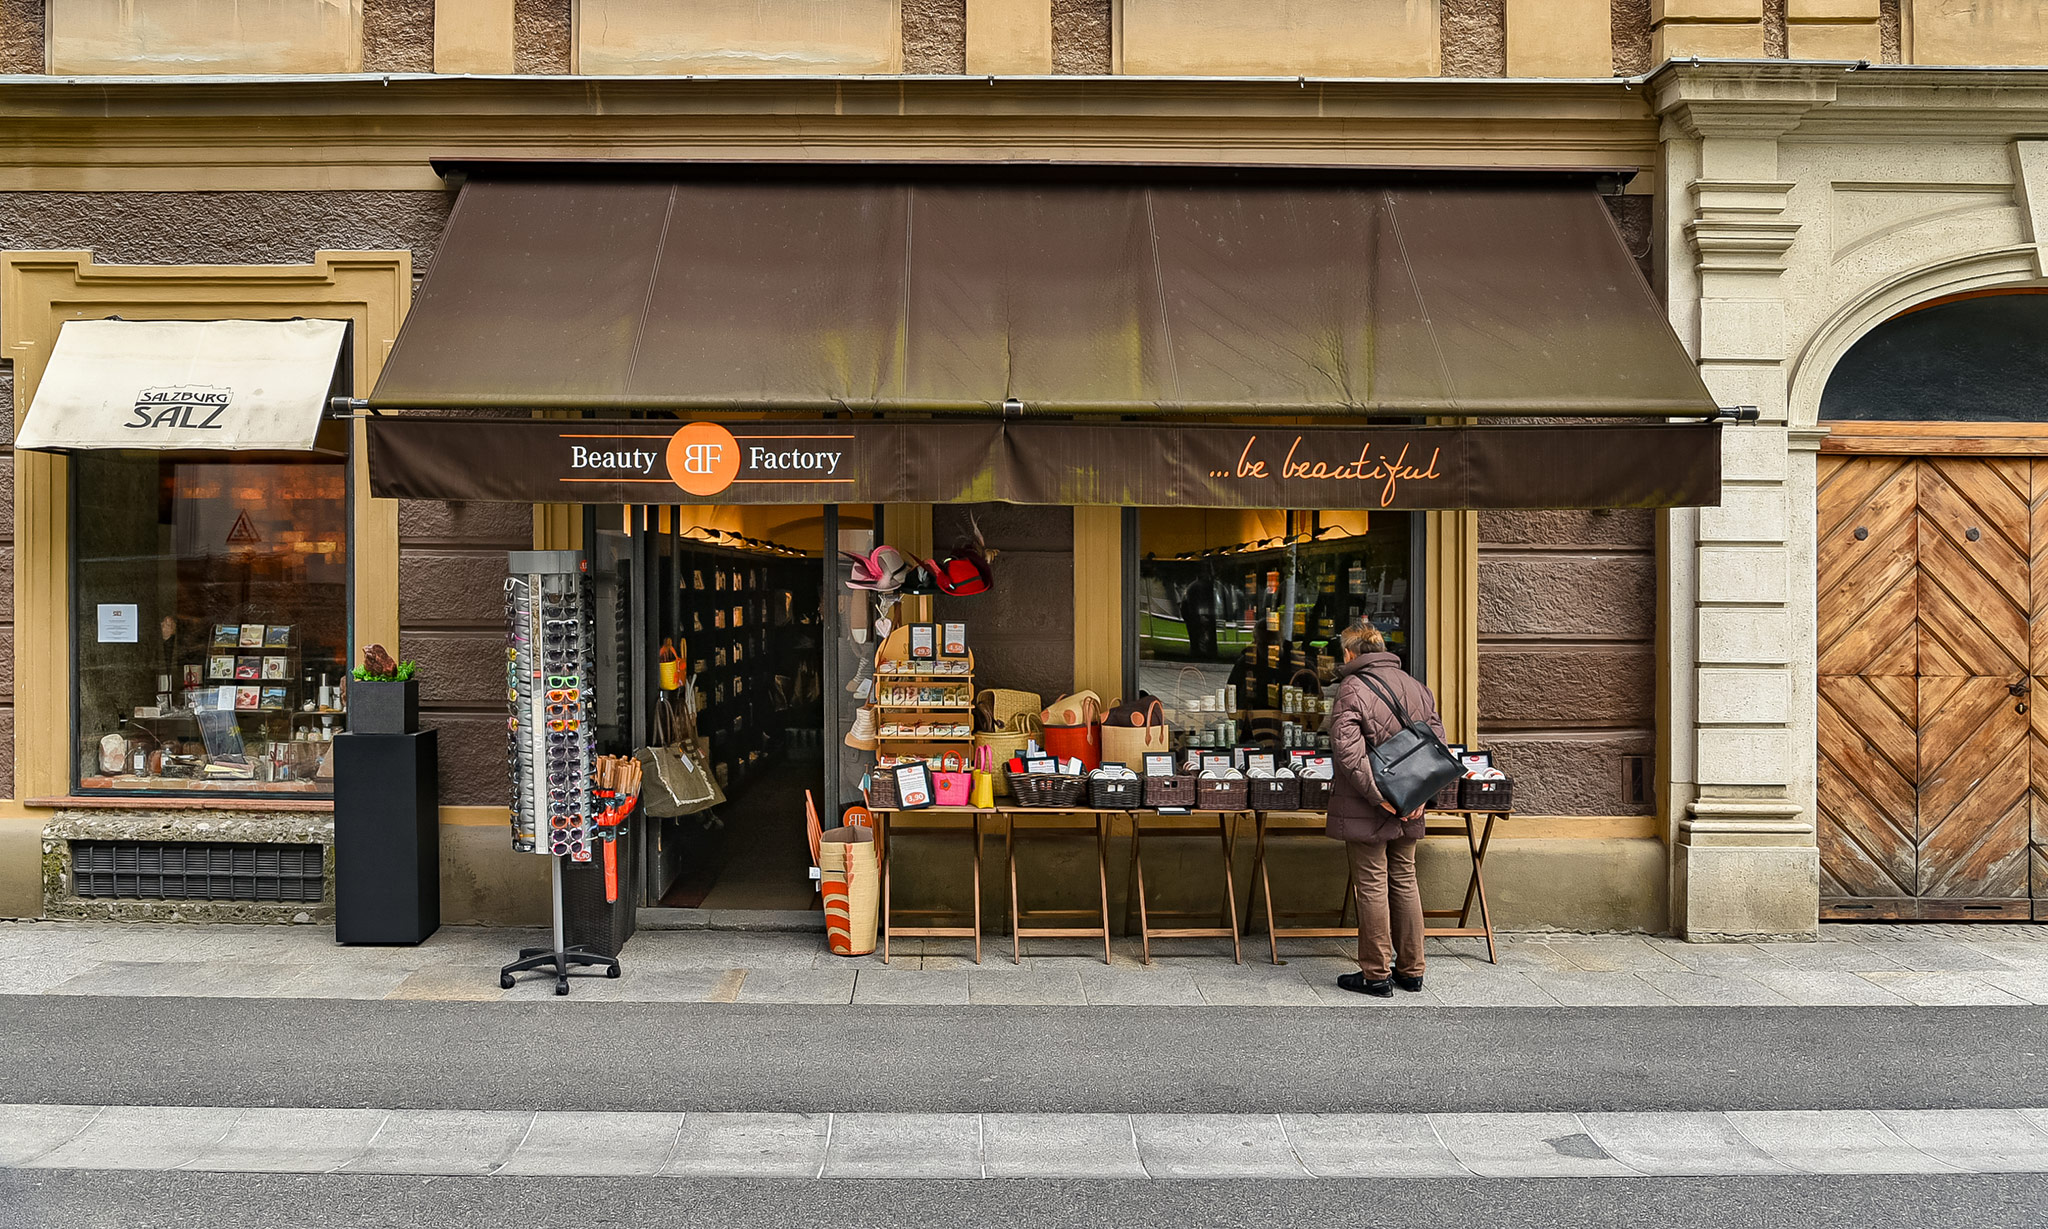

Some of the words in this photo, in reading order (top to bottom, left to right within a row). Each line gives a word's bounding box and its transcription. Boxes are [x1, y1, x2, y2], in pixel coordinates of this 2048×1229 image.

[140, 392, 228, 403] SALZBURG
[123, 404, 229, 429] SALZ
[571, 445, 657, 475] Beauty
[749, 446, 842, 475] Factory
[1282, 435, 1441, 507] beautiful
[908, 794, 924, 802] 3,90
